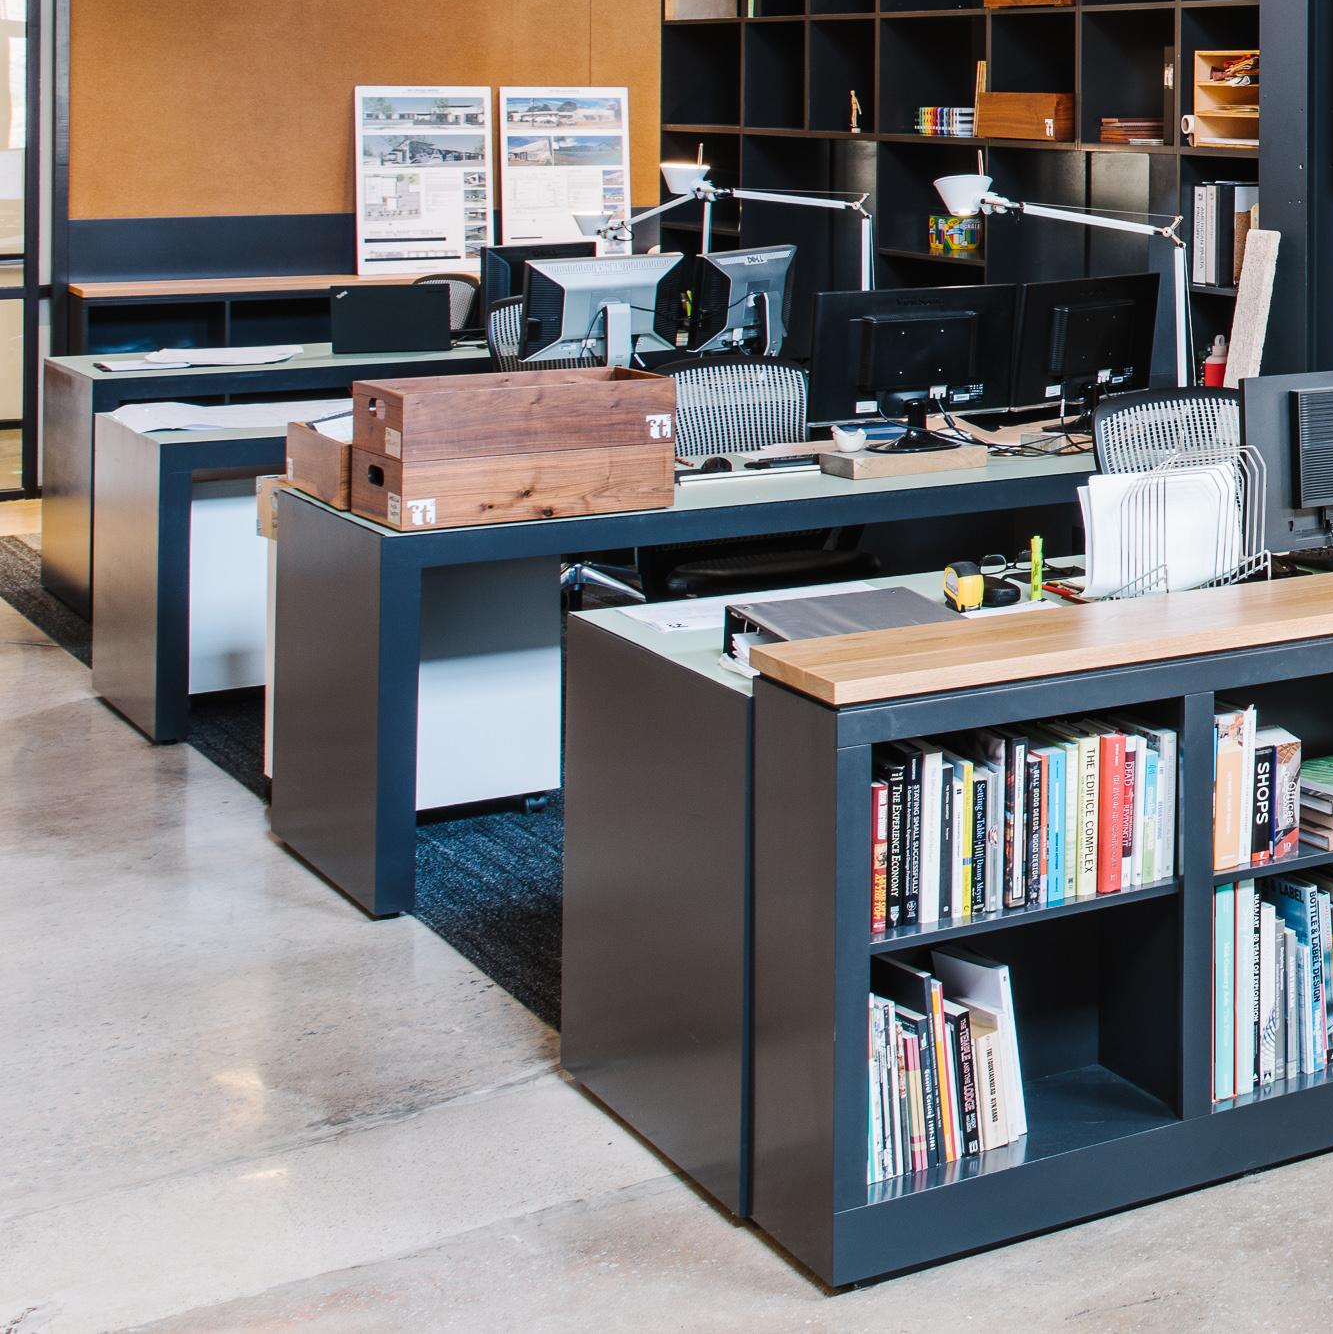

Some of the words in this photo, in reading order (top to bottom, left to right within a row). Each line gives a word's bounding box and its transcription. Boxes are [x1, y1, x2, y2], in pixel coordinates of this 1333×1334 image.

[747, 255, 765, 264] DELL
[1086, 748, 1096, 770] THE
[1168, 755, 1173, 764] AN
[893, 785, 902, 803] THE
[975, 783, 985, 811] Setting
[1085, 774, 1095, 817] EDIFICE
[1146, 787, 1156, 815] cradle
[1256, 762, 1269, 825] SHOPS
[1286, 782, 1296, 824] Offices
[891, 804, 902, 854] EXPERIENCE
[976, 818, 985, 839] Table
[1122, 804, 1131, 838] REVIVING
[1084, 821, 1095, 873] COMPLEX
[1122, 839, 1131, 847] IT
[874, 874, 880, 885] AT
[891, 855, 901, 897] ECONOMY
[975, 859, 984, 880] Danny
[975, 882, 984, 903] Meyer
[1309, 891, 1317, 927] BOTTLE
[1253, 933, 1260, 943] 50
[1311, 937, 1319, 967] LABEL
[1222, 941, 1231, 990] Mid-Century
[1253, 964, 1259, 974] OF
[1313, 969, 1321, 1003] DESIGN
[959, 1028, 971, 1062] TEMPLE
[924, 1069, 933, 1093] General
[963, 1073, 971, 1084] THE
[987, 1058, 996, 1095] FOUNTAINHEAD
[926, 1095, 935, 1119] Catalog
[963, 1083, 975, 1112] LODGE
